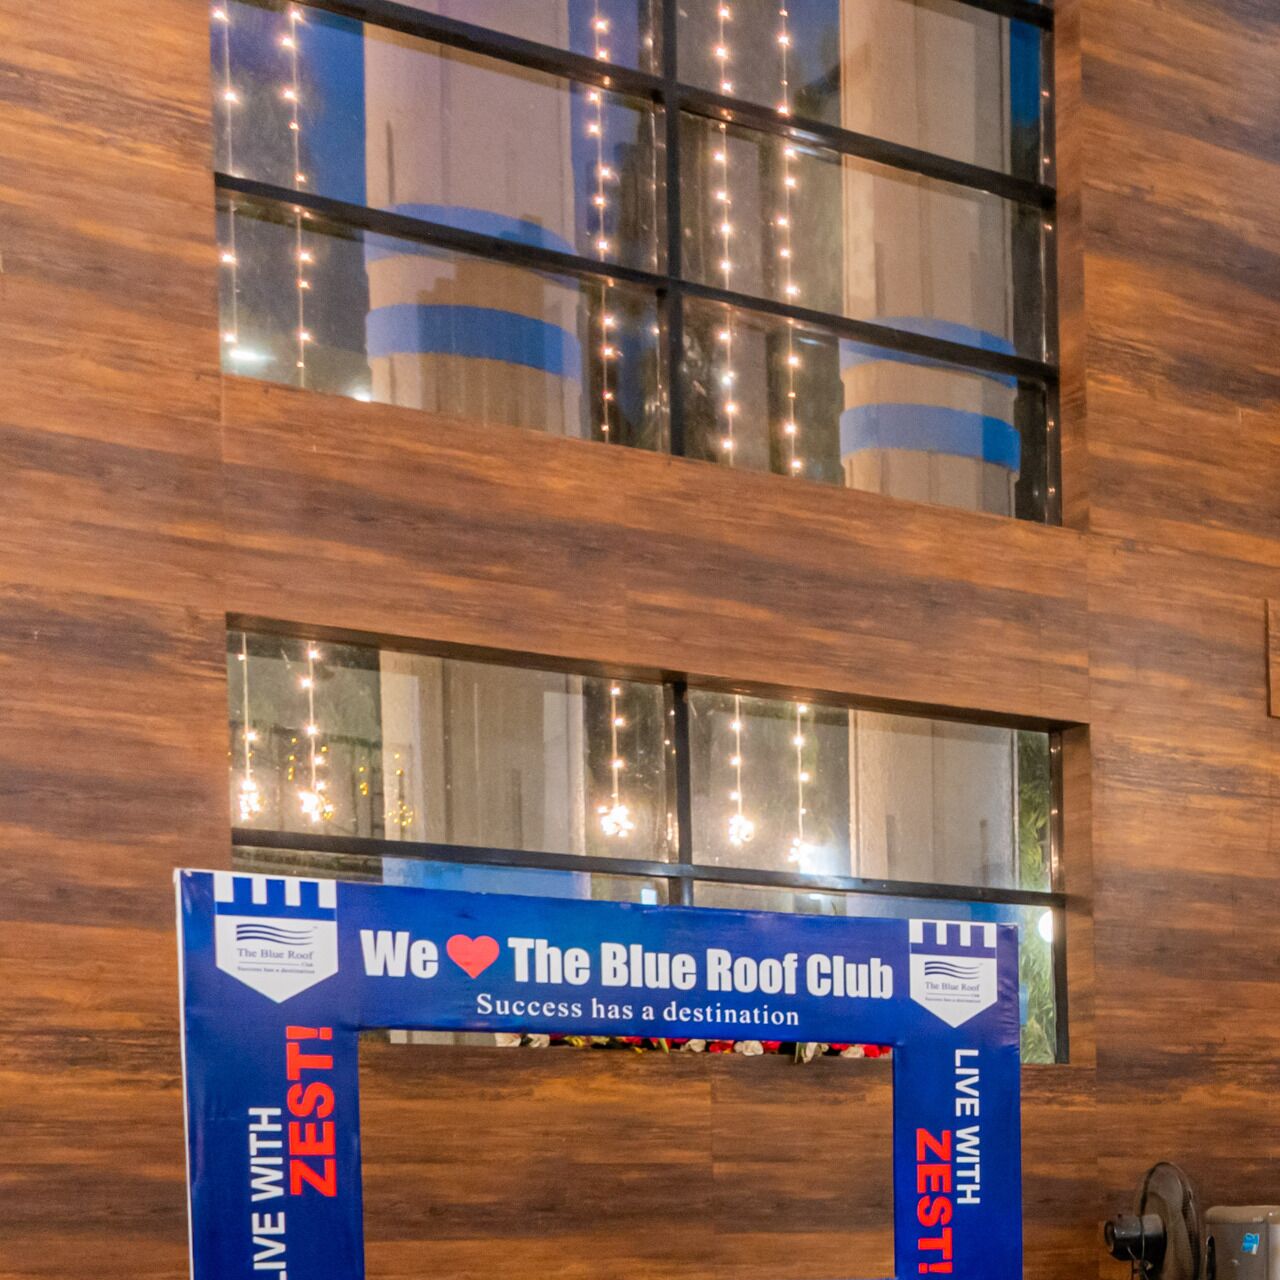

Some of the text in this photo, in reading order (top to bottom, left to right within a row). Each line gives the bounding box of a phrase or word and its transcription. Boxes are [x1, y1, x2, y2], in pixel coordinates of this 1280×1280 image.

[260, 949, 284, 959] Blue
[287, 950, 314, 960] Roof
[359, 929, 894, 1000] We The Blue Roof Club
[476, 992, 800, 1027] Success has a destination
[248, 1107, 284, 1202] WITH
[286, 1025, 337, 1197] ZEST!
[955, 1049, 981, 1204] LIVE WITH
[916, 1128, 953, 1274] ZEST!
